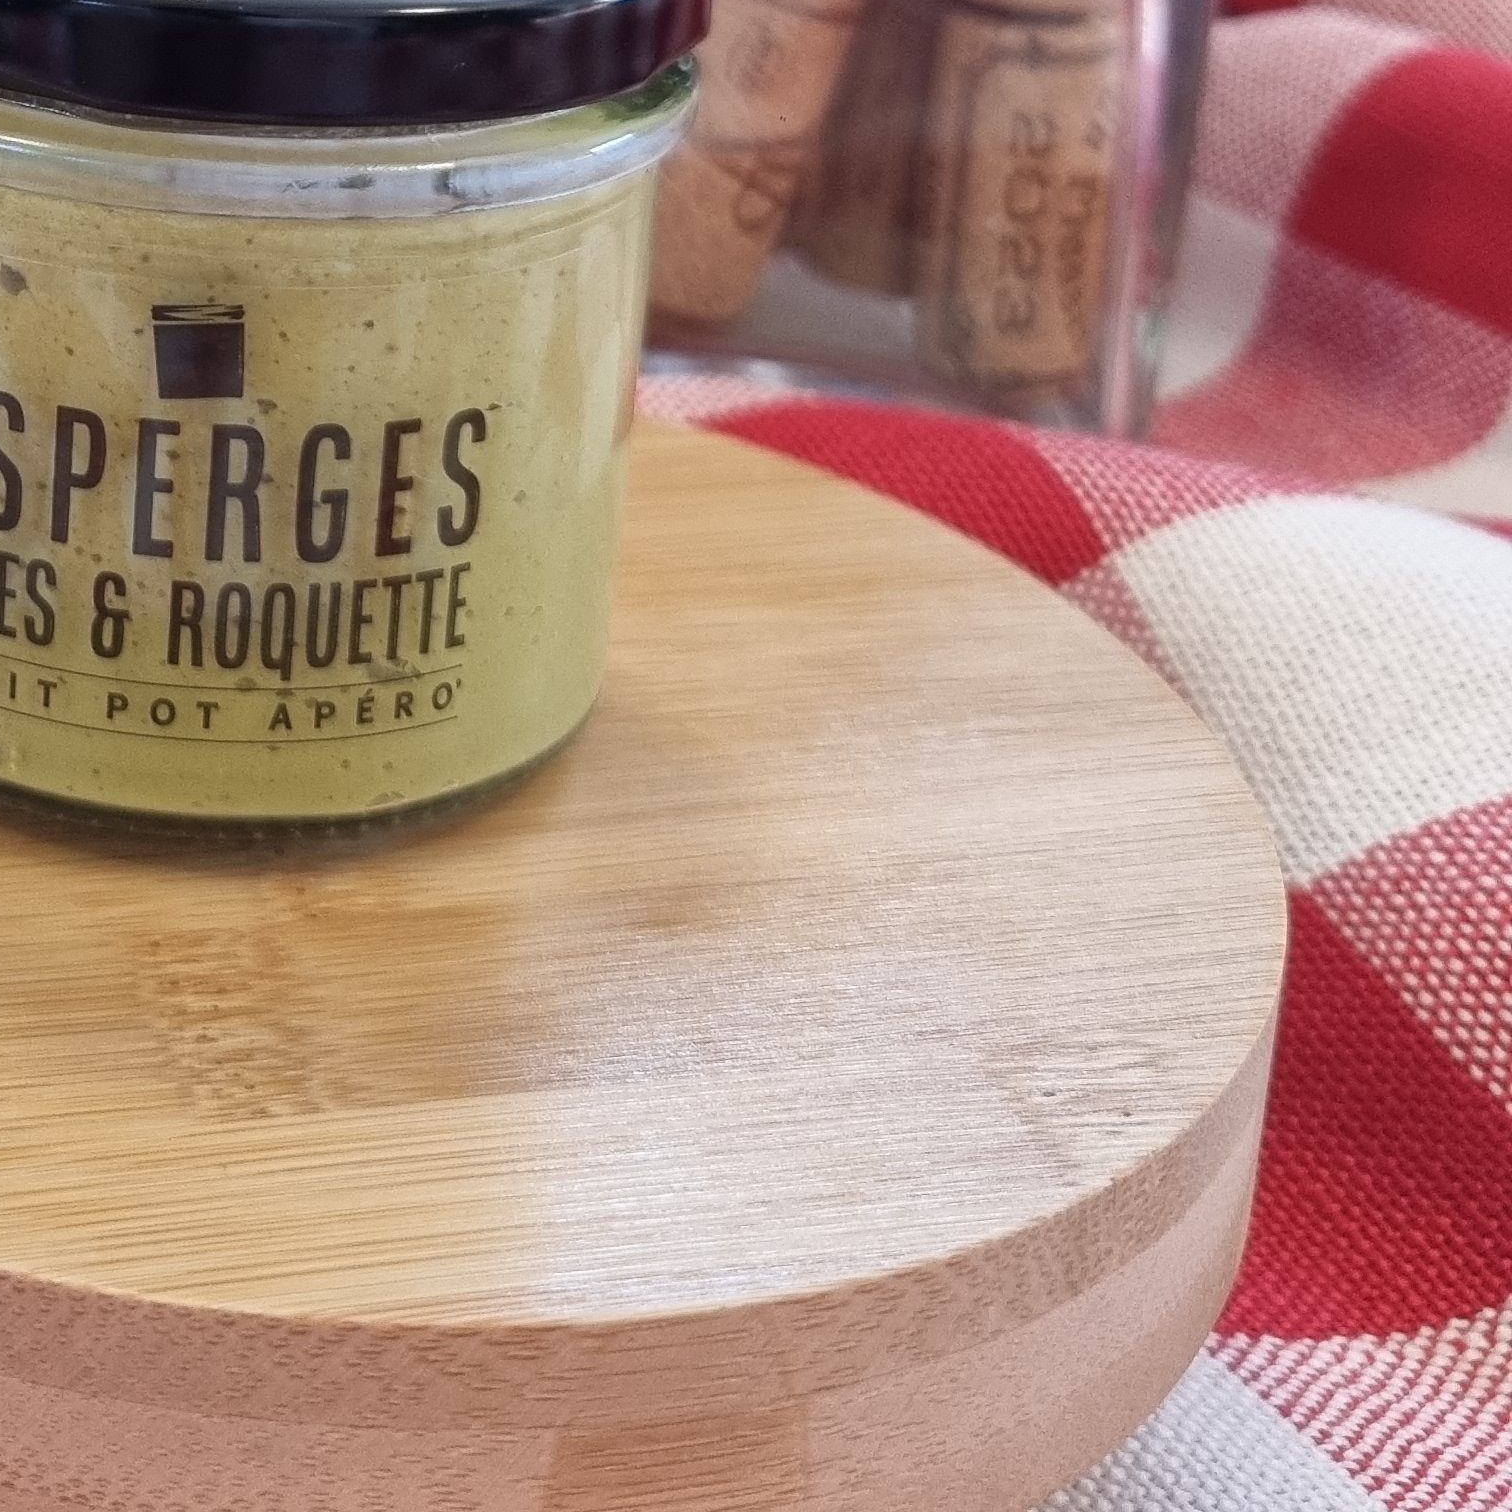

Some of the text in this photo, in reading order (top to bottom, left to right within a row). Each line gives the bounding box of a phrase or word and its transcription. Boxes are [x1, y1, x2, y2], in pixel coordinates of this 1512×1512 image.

[90, 570, 131, 659] &
[167, 561, 471, 683] ROQUETTE
[106, 692, 220, 730] POT
